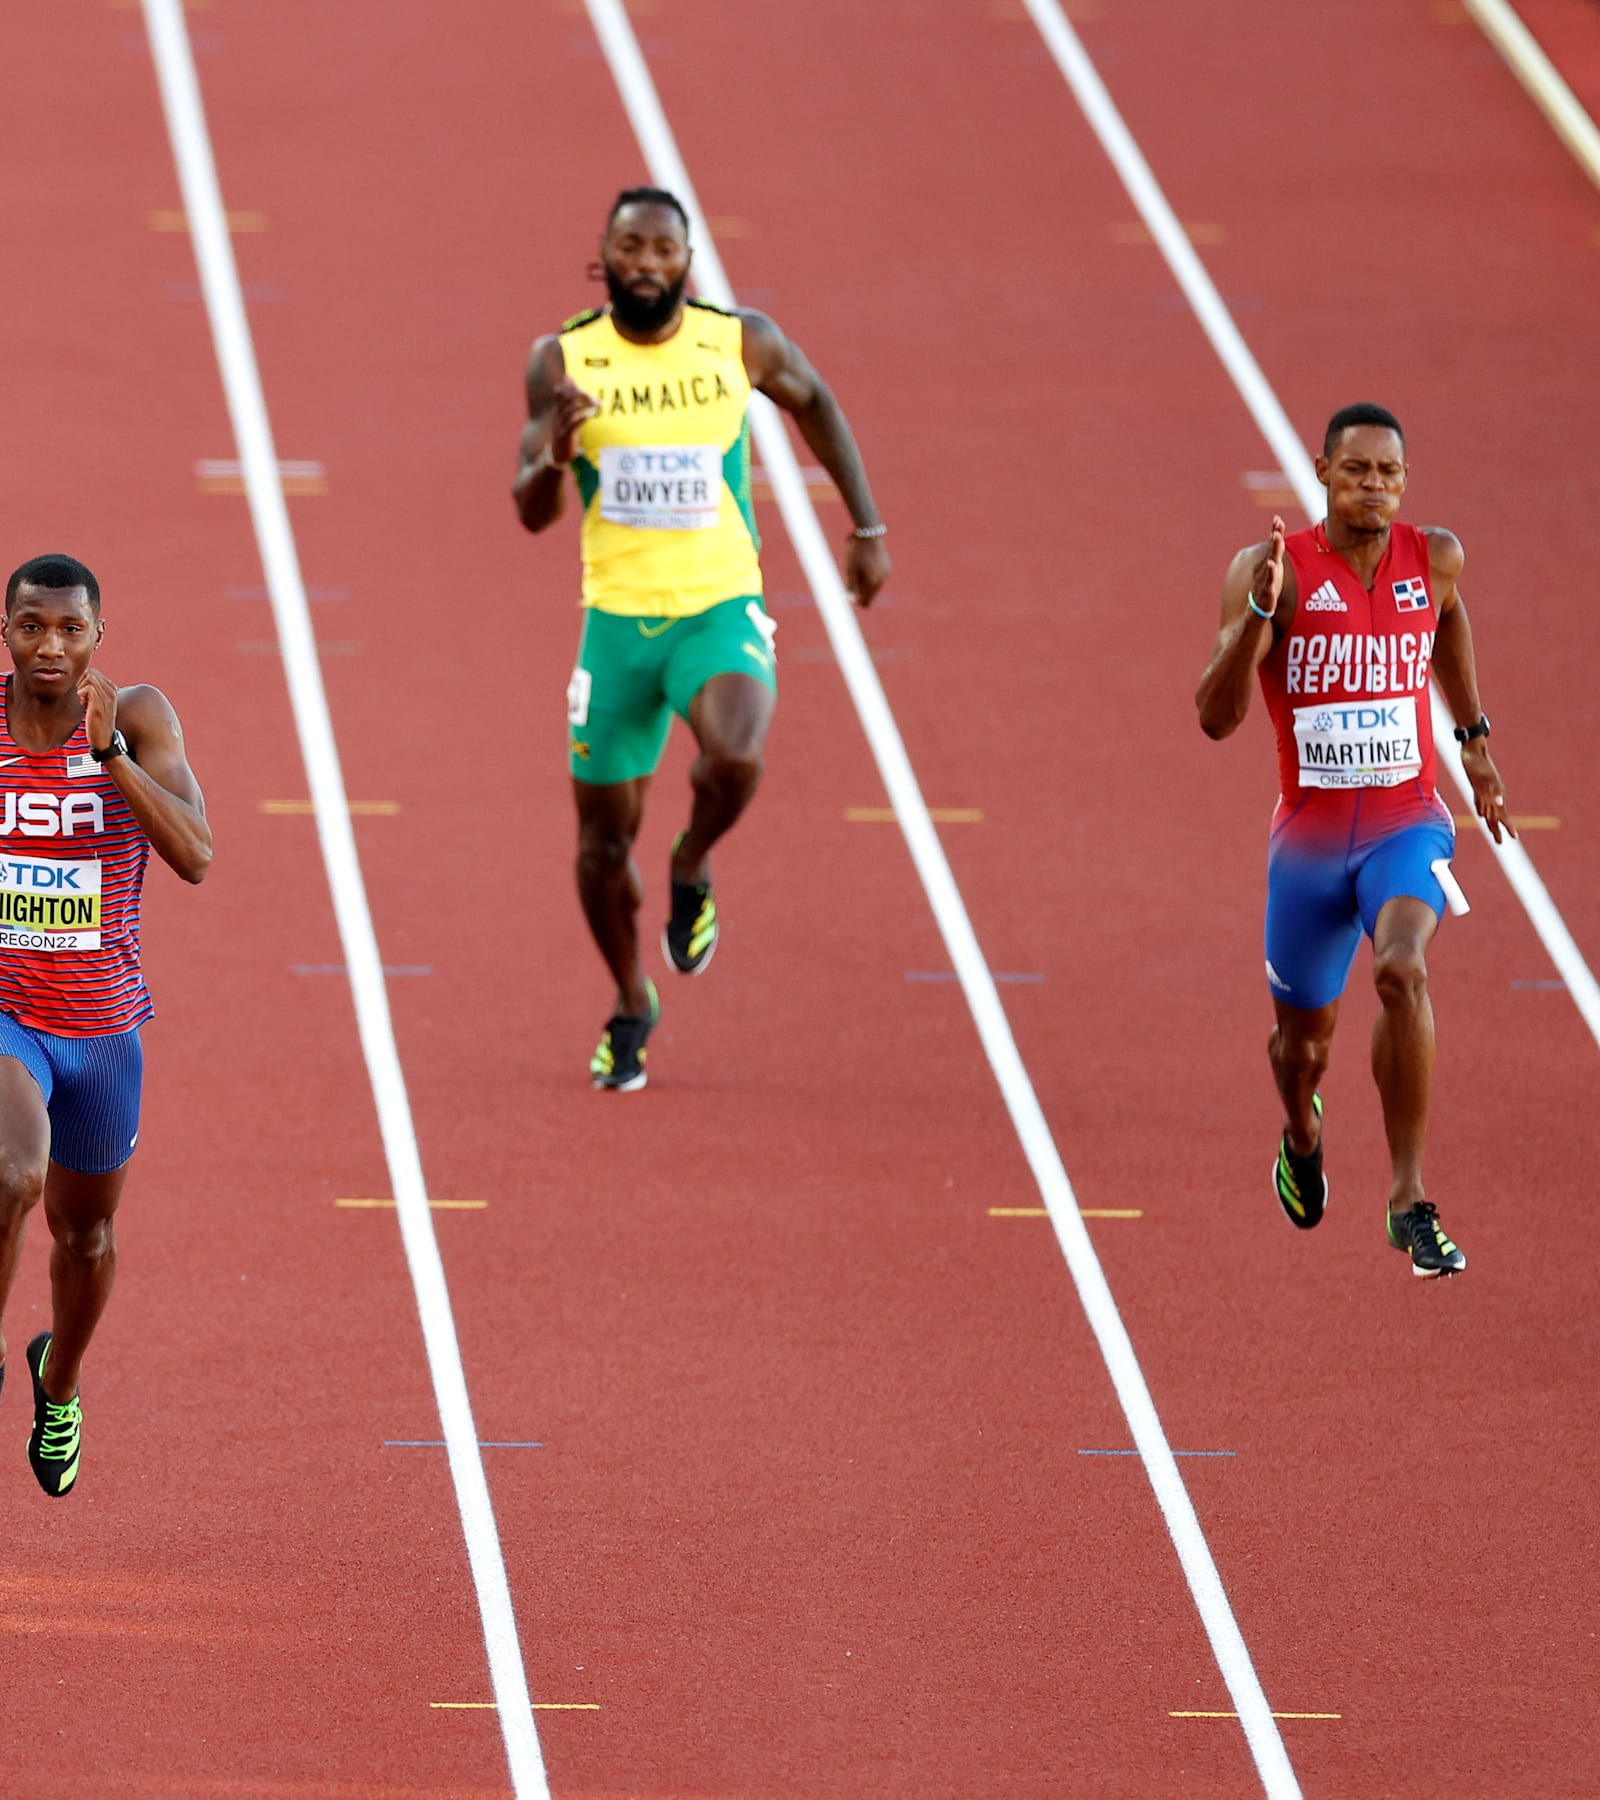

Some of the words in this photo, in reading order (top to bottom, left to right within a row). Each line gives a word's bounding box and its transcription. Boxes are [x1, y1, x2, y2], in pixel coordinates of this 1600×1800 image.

[639, 453, 702, 473] TDK
[615, 479, 708, 504] DWYER
[1304, 600, 1348, 613] adidas
[1286, 662, 1429, 694] REPUBLIC
[1332, 706, 1400, 730] TDK
[1305, 737, 1414, 766] MARTÍNEZ
[8, 862, 81, 889] TDK
